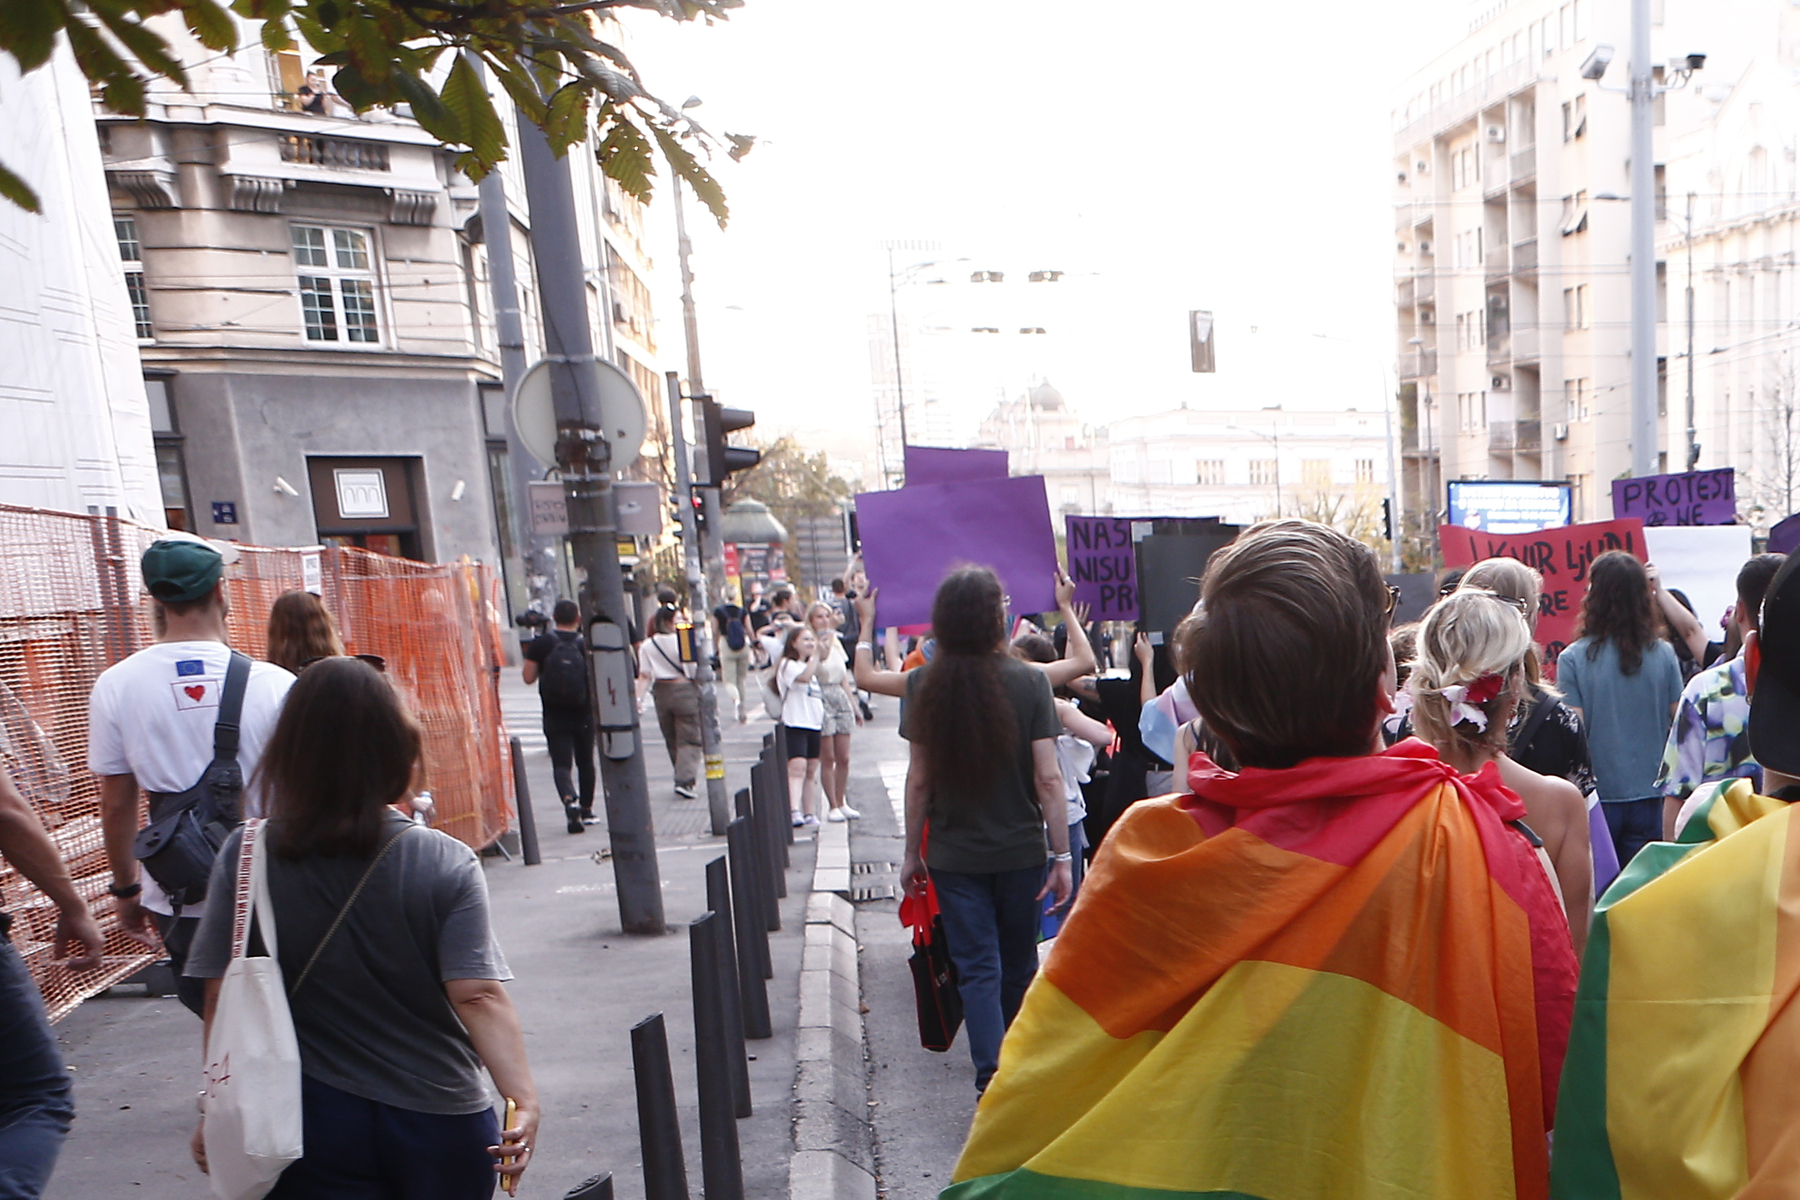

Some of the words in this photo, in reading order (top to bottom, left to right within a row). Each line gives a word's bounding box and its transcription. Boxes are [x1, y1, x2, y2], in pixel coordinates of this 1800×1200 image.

[1623, 470, 1734, 512] PROTEST
[1676, 503, 1704, 526] NE
[1074, 555, 1131, 582] NISU
